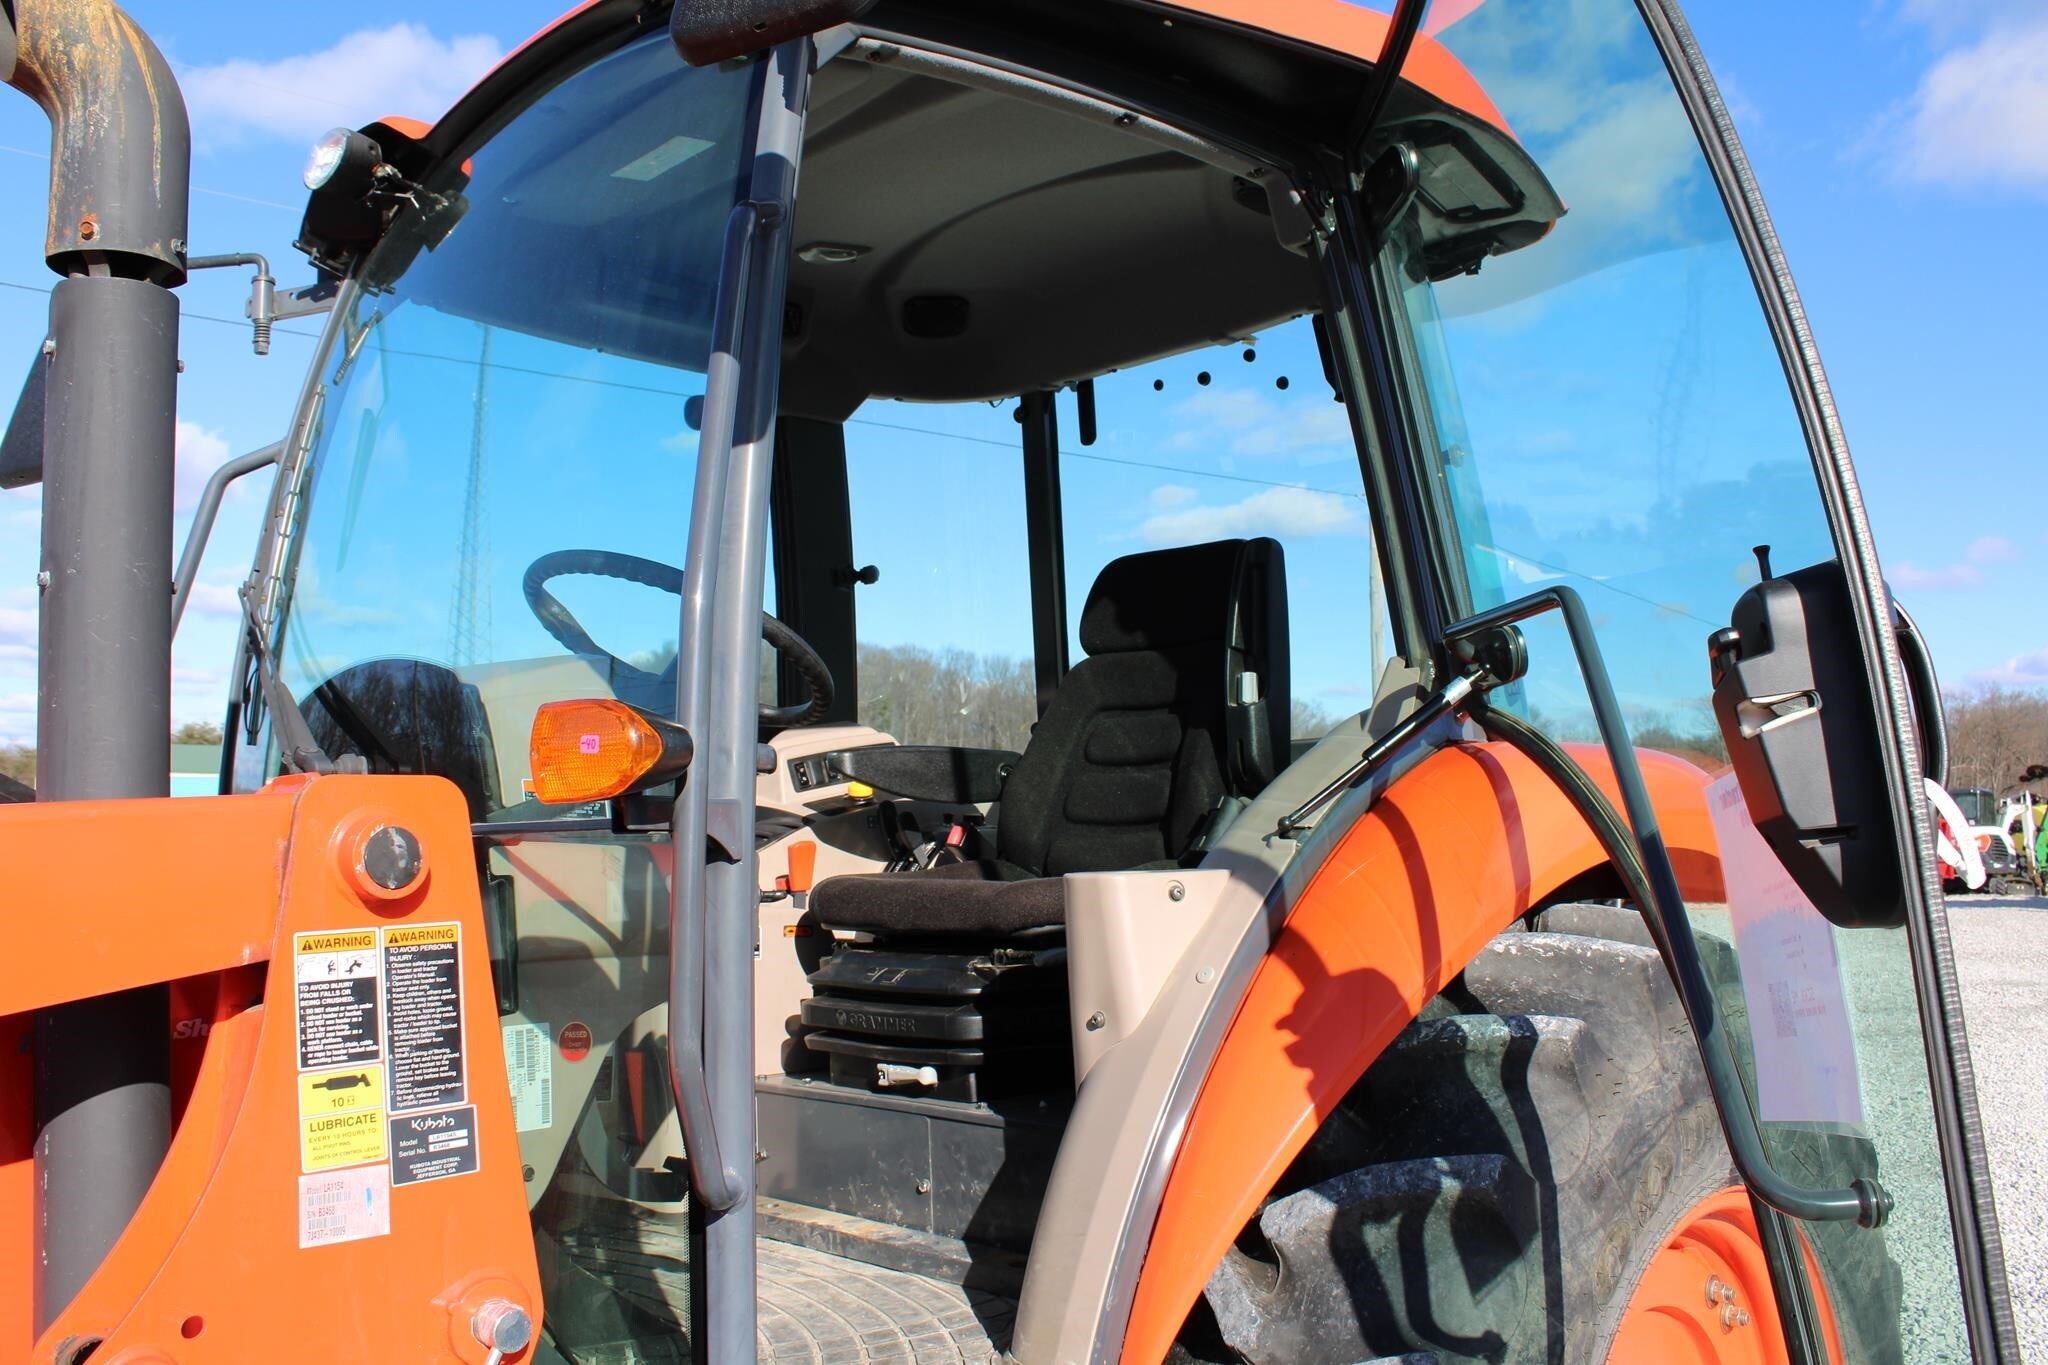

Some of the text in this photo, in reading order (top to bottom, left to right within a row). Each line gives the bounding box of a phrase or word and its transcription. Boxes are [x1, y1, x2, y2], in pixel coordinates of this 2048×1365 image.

[399, 929, 454, 942] WARNING
[314, 936, 371, 949] WARNING
[173, 1018, 210, 1039] Sh
[850, 1013, 916, 1032] GRAMMER
[332, 1097, 344, 1107] 10
[310, 1113, 376, 1132] LUBRICATE
[411, 1115, 454, 1130] Kubota
[399, 1149, 415, 1157] Serial
[431, 1157, 461, 1165] INDUSTRIAL
[413, 1165, 442, 1174] EQUIPMENT
